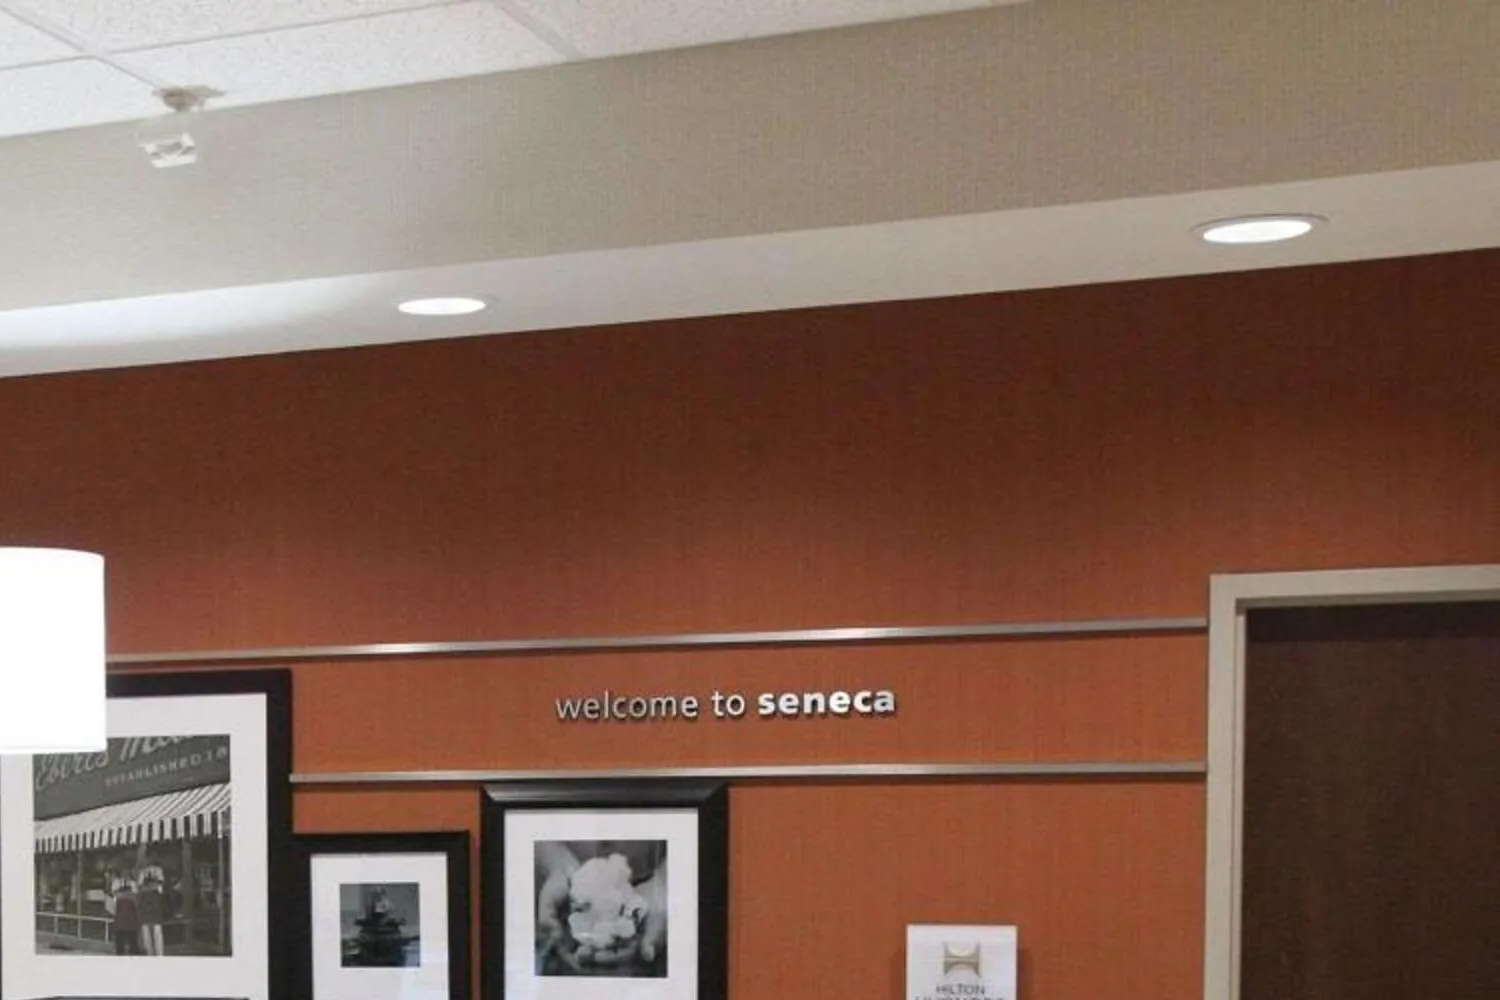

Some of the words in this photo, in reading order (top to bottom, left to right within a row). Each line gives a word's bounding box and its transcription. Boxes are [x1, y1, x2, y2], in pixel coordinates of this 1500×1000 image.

[555, 689, 699, 719] welcome
[711, 690, 745, 717] to
[757, 689, 896, 716] seneca
[936, 984, 986, 995] HILTON
